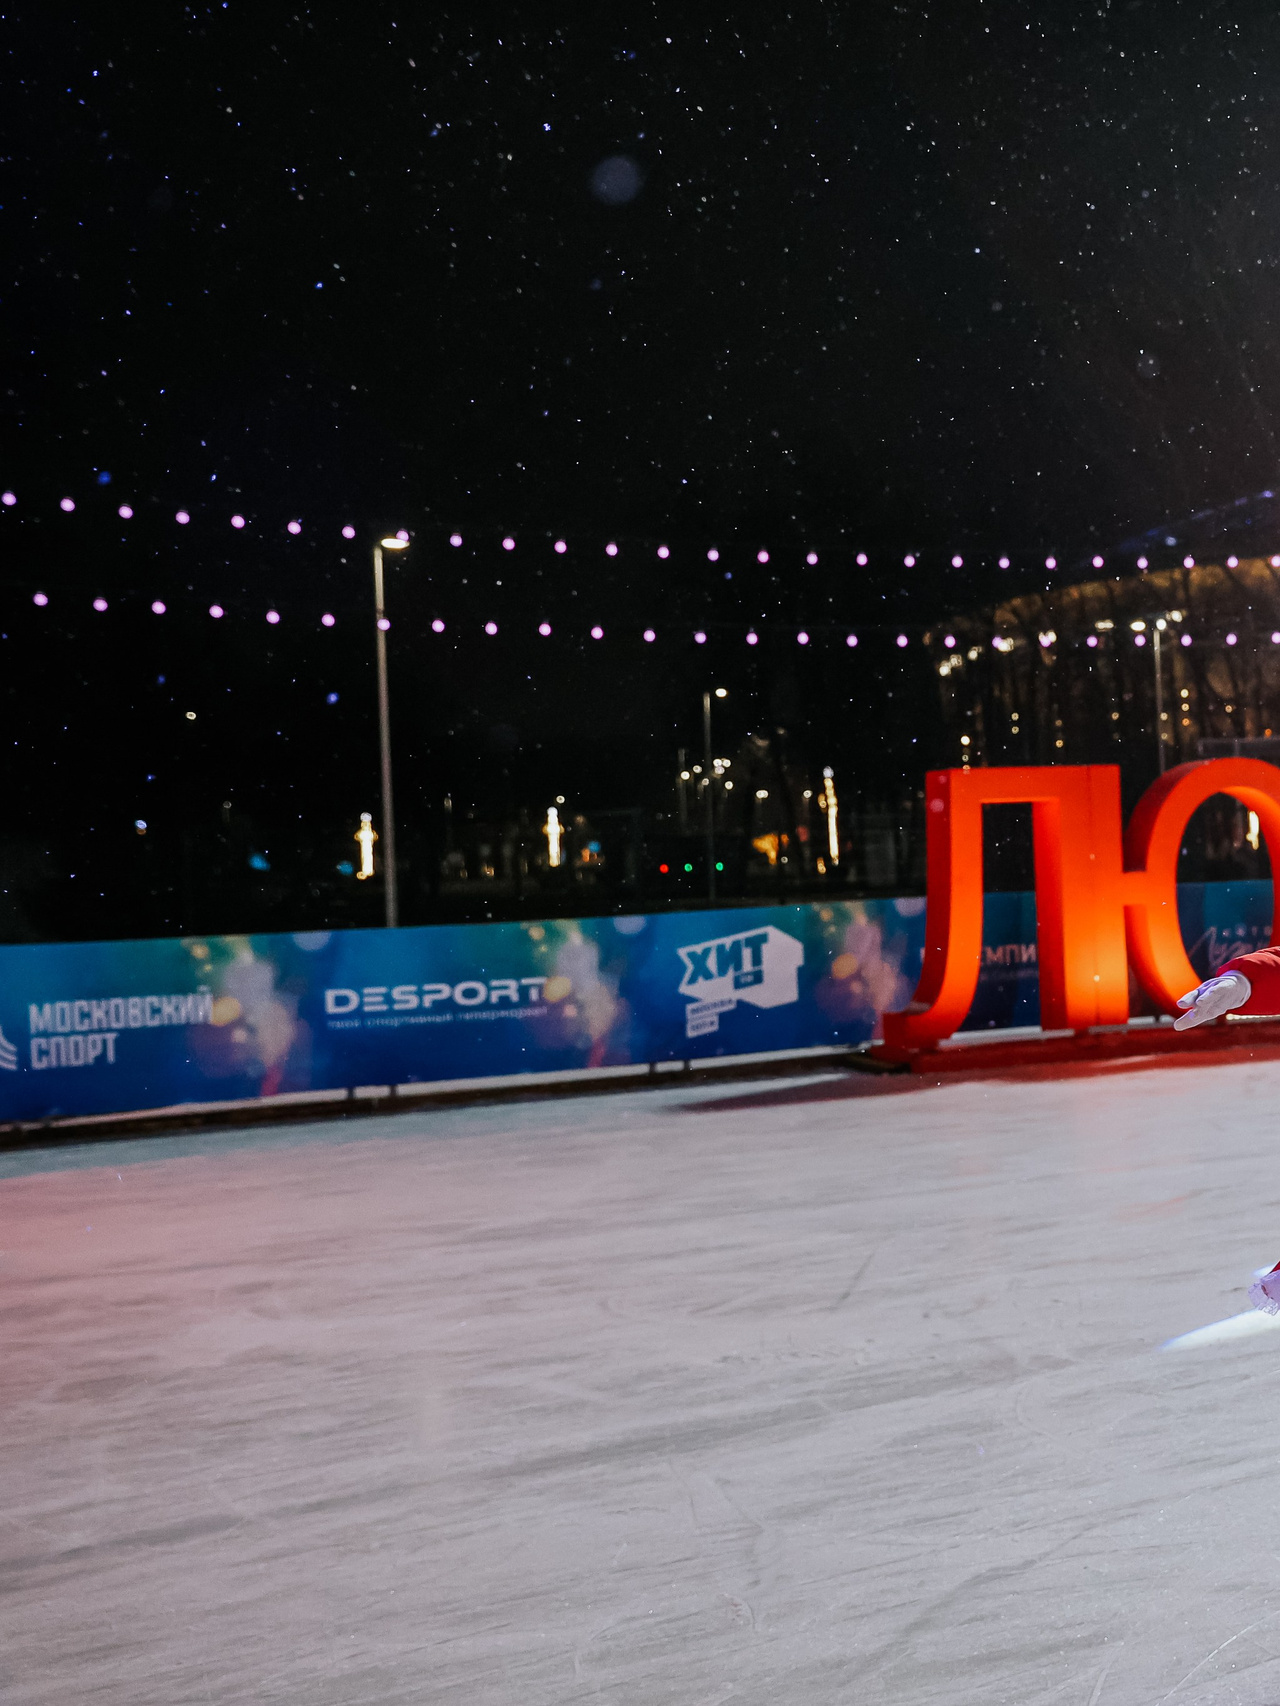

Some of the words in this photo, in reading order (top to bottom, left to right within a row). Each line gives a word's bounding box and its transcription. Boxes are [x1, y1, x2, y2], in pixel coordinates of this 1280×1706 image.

[686, 932, 769, 986] ХИТ
[28, 985, 213, 1035] МОСКОВСКИЙ
[324, 976, 548, 1015] DESPORT
[30, 1031, 119, 1070] СПОРТ
